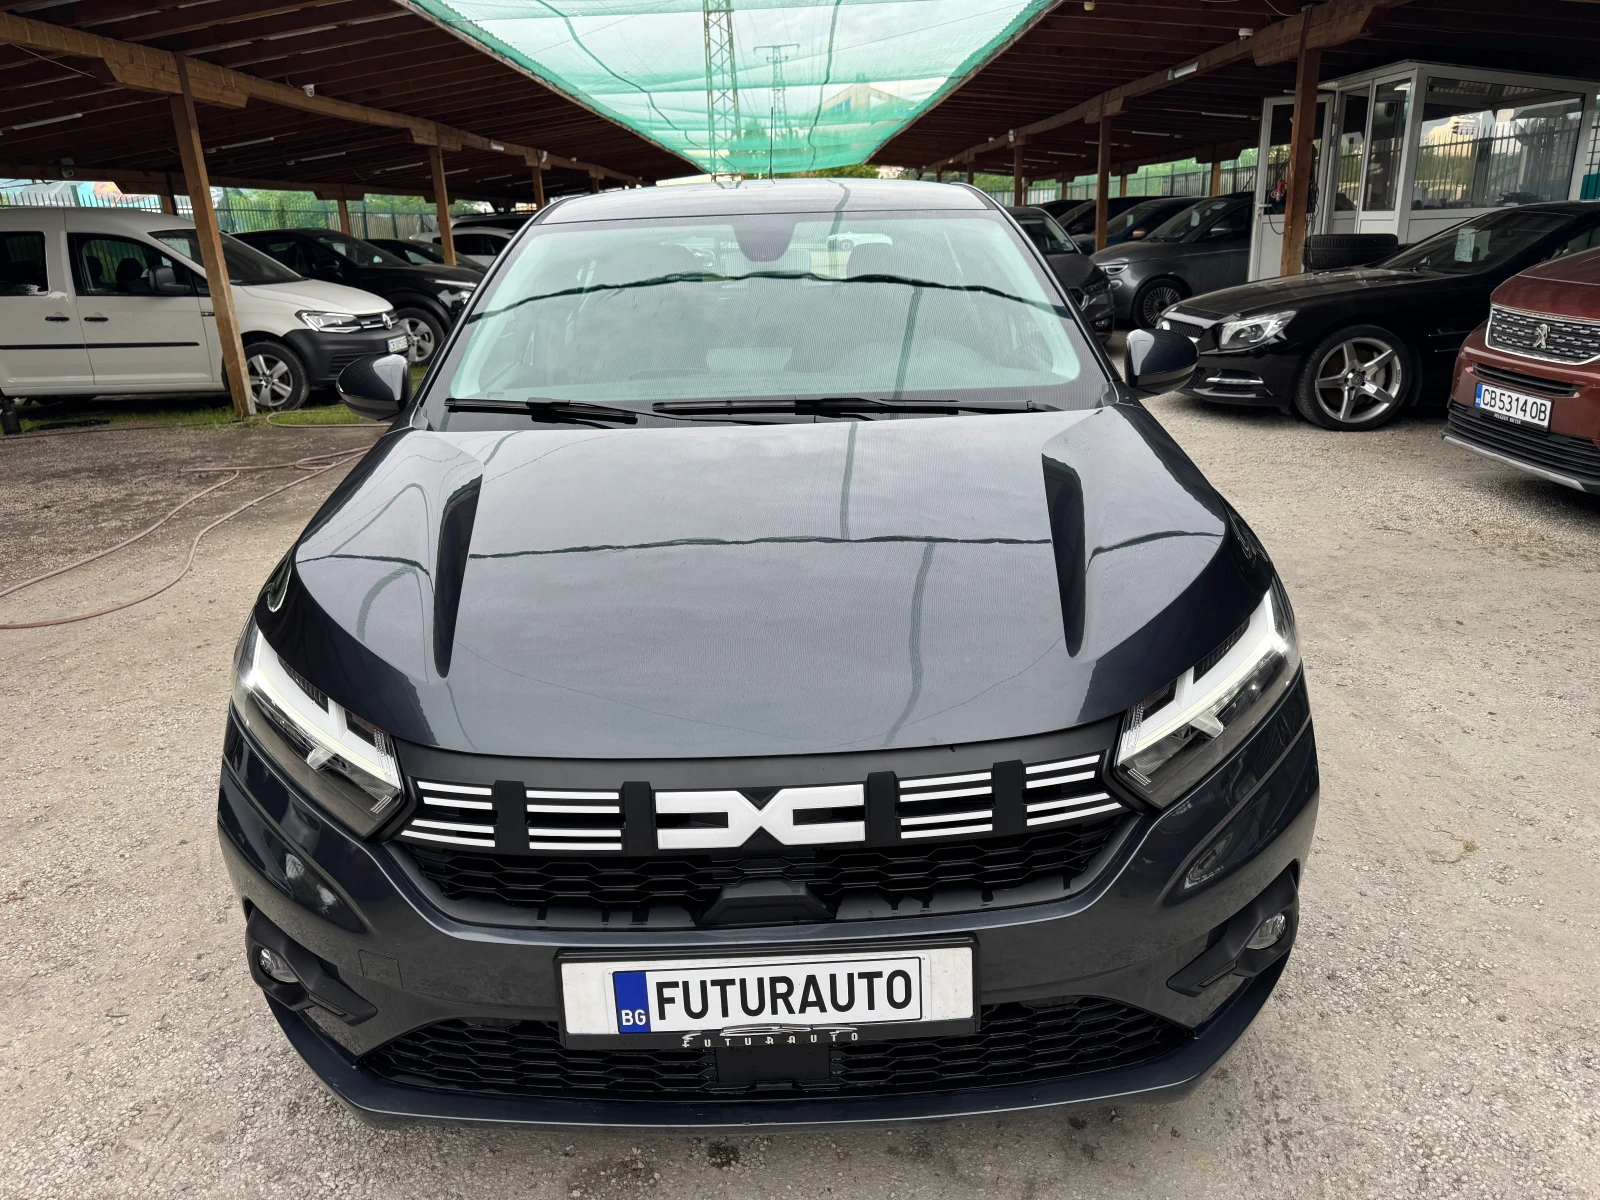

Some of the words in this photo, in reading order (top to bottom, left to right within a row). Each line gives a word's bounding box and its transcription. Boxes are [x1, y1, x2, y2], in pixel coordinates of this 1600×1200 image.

[1498, 393, 1528, 417] 5314
[655, 969, 912, 1021] FUTURAUTO
[621, 1009, 647, 1026] BG
[682, 1031, 858, 1048] FUTURAUTO
